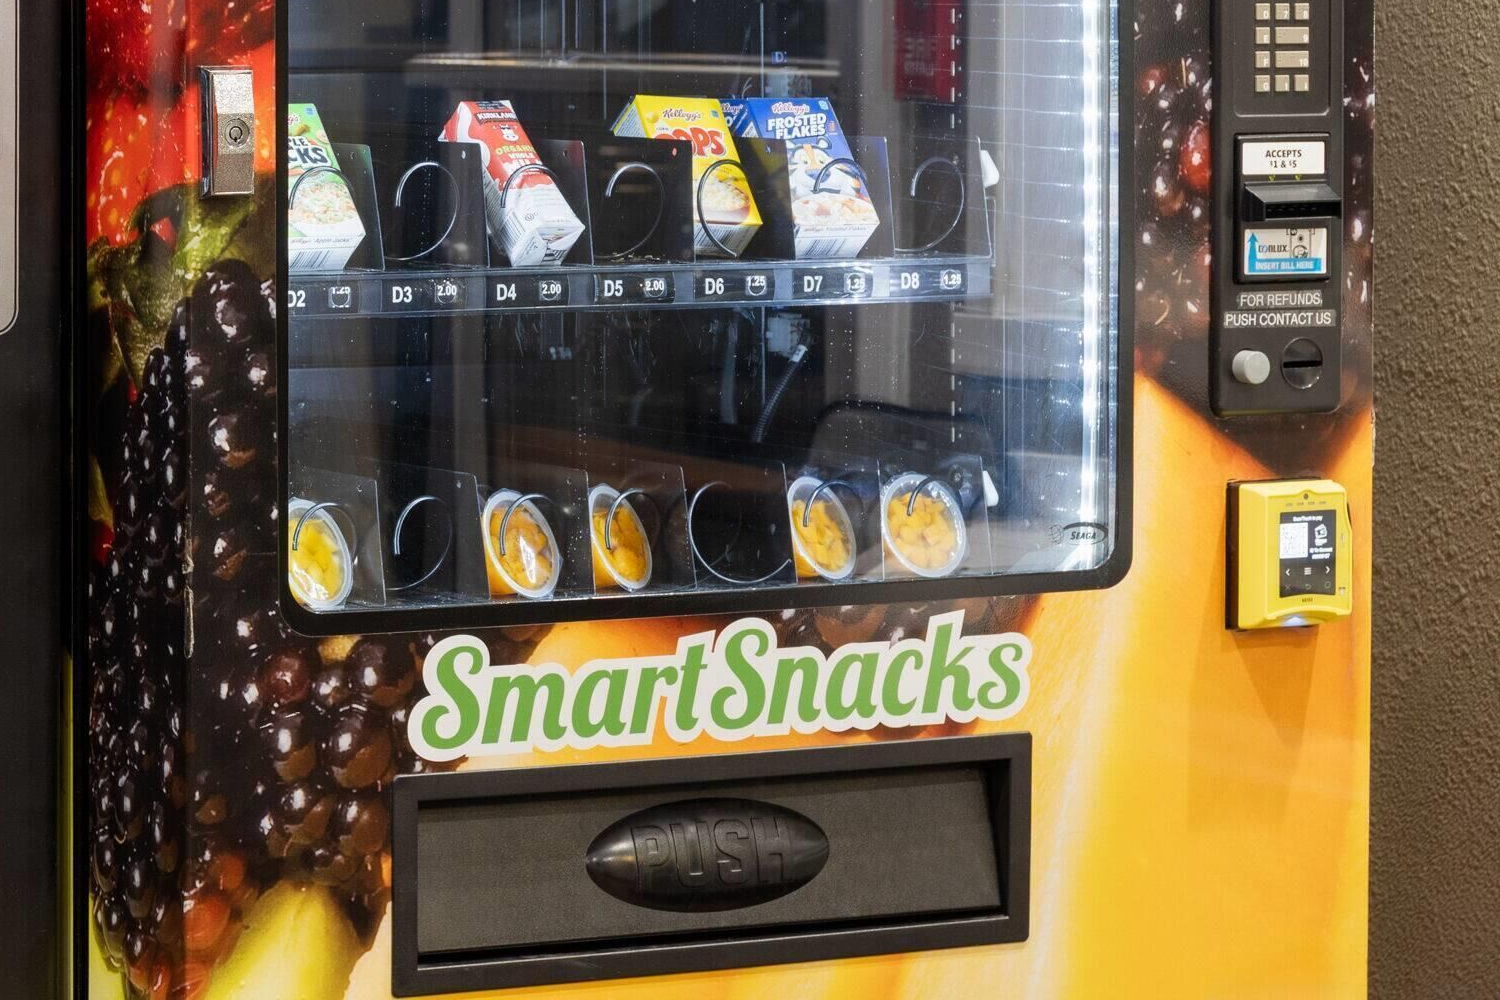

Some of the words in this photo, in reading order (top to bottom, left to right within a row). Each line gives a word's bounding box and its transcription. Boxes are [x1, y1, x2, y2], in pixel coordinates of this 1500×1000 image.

[767, 113, 828, 131] FROSTED
[775, 124, 827, 139] FLAKES
[1265, 149, 1302, 158] ACCEPTS
[1269, 160, 1278, 168] $1
[1280, 160, 1286, 168] &
[1288, 160, 1297, 168] $5
[1255, 261, 1280, 270] INSERT
[1280, 261, 1295, 270] BILL
[1296, 261, 1315, 269] HERE
[604, 279, 623, 297] D5
[645, 280, 665, 292] 2.00
[704, 277, 725, 294] D6
[746, 275, 765, 287] 1.25
[803, 275, 823, 292] D7
[845, 277, 865, 289] 1.25
[901, 272, 919, 289] D8
[942, 273, 961, 285] 1.25
[392, 286, 413, 303] D3
[437, 285, 457, 296] 2.00
[496, 283, 517, 300] D4
[541, 283, 562, 295] 2.00
[1239, 294, 1264, 307] FOR
[1225, 313, 1257, 326] PUSH
[1259, 312, 1314, 326] CONTACT
[1315, 312, 1331, 325] US
[1070, 530, 1097, 540] SEAGA
[415, 617, 1027, 756] SmartSnacks
[631, 813, 793, 892] PUSH
